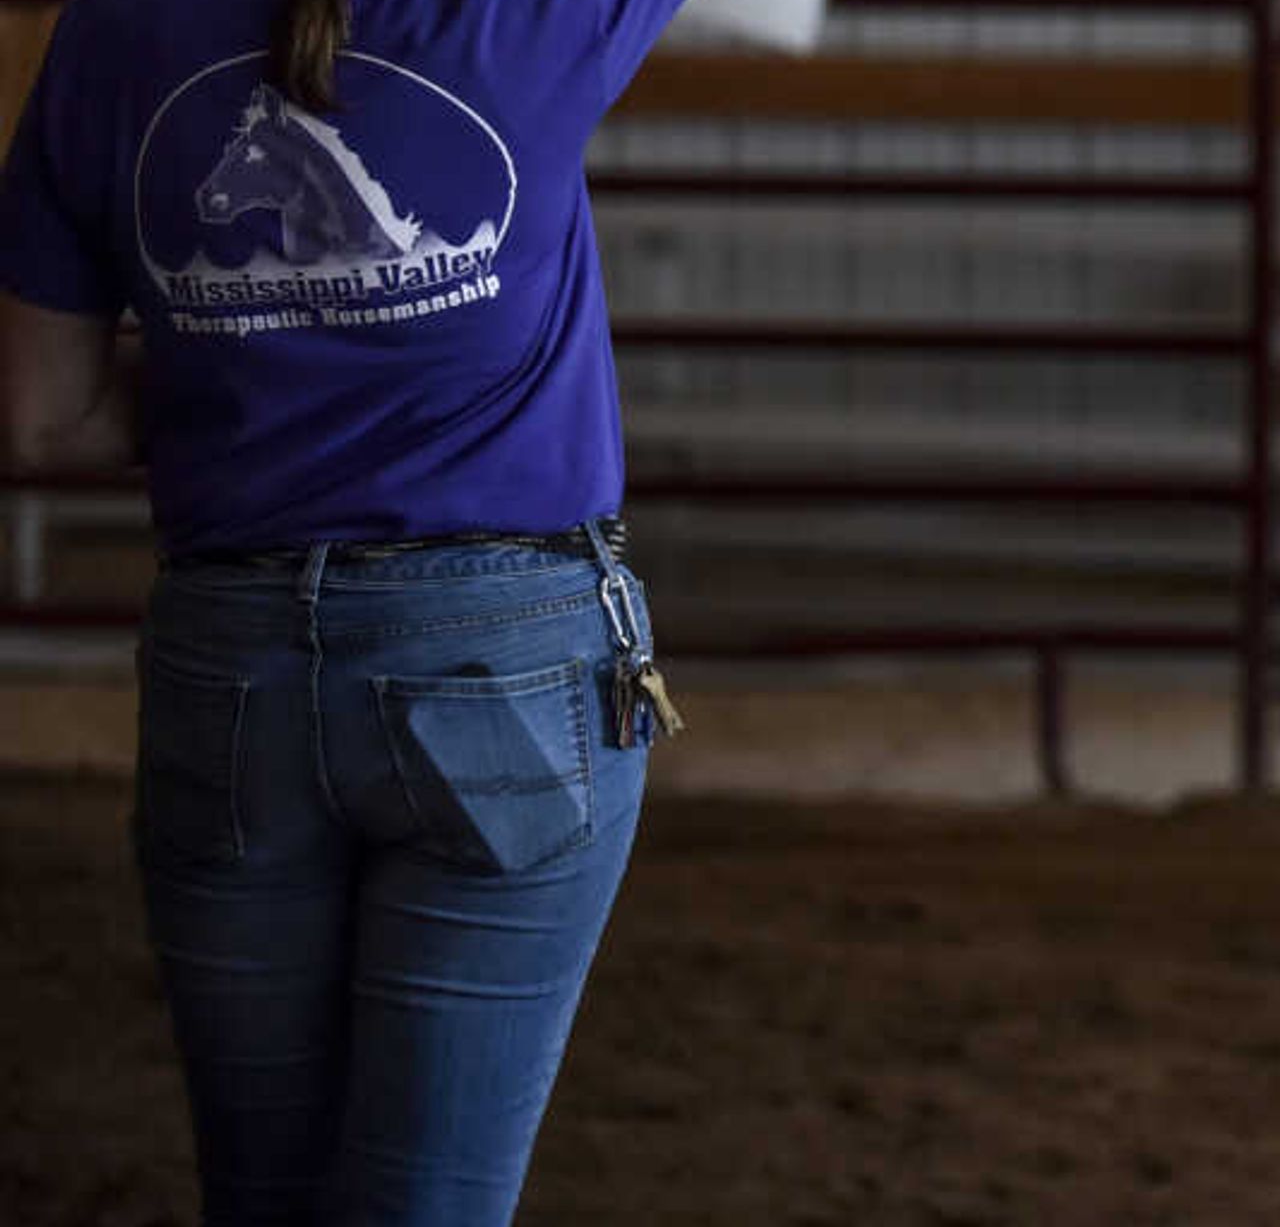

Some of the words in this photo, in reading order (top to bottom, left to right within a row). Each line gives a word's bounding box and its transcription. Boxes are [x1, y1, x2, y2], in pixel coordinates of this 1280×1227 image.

[166, 270, 365, 306] Mississippi
[376, 247, 493, 293] Valley
[171, 308, 313, 338] Therapeutic
[320, 274, 501, 326] Horsemanship
